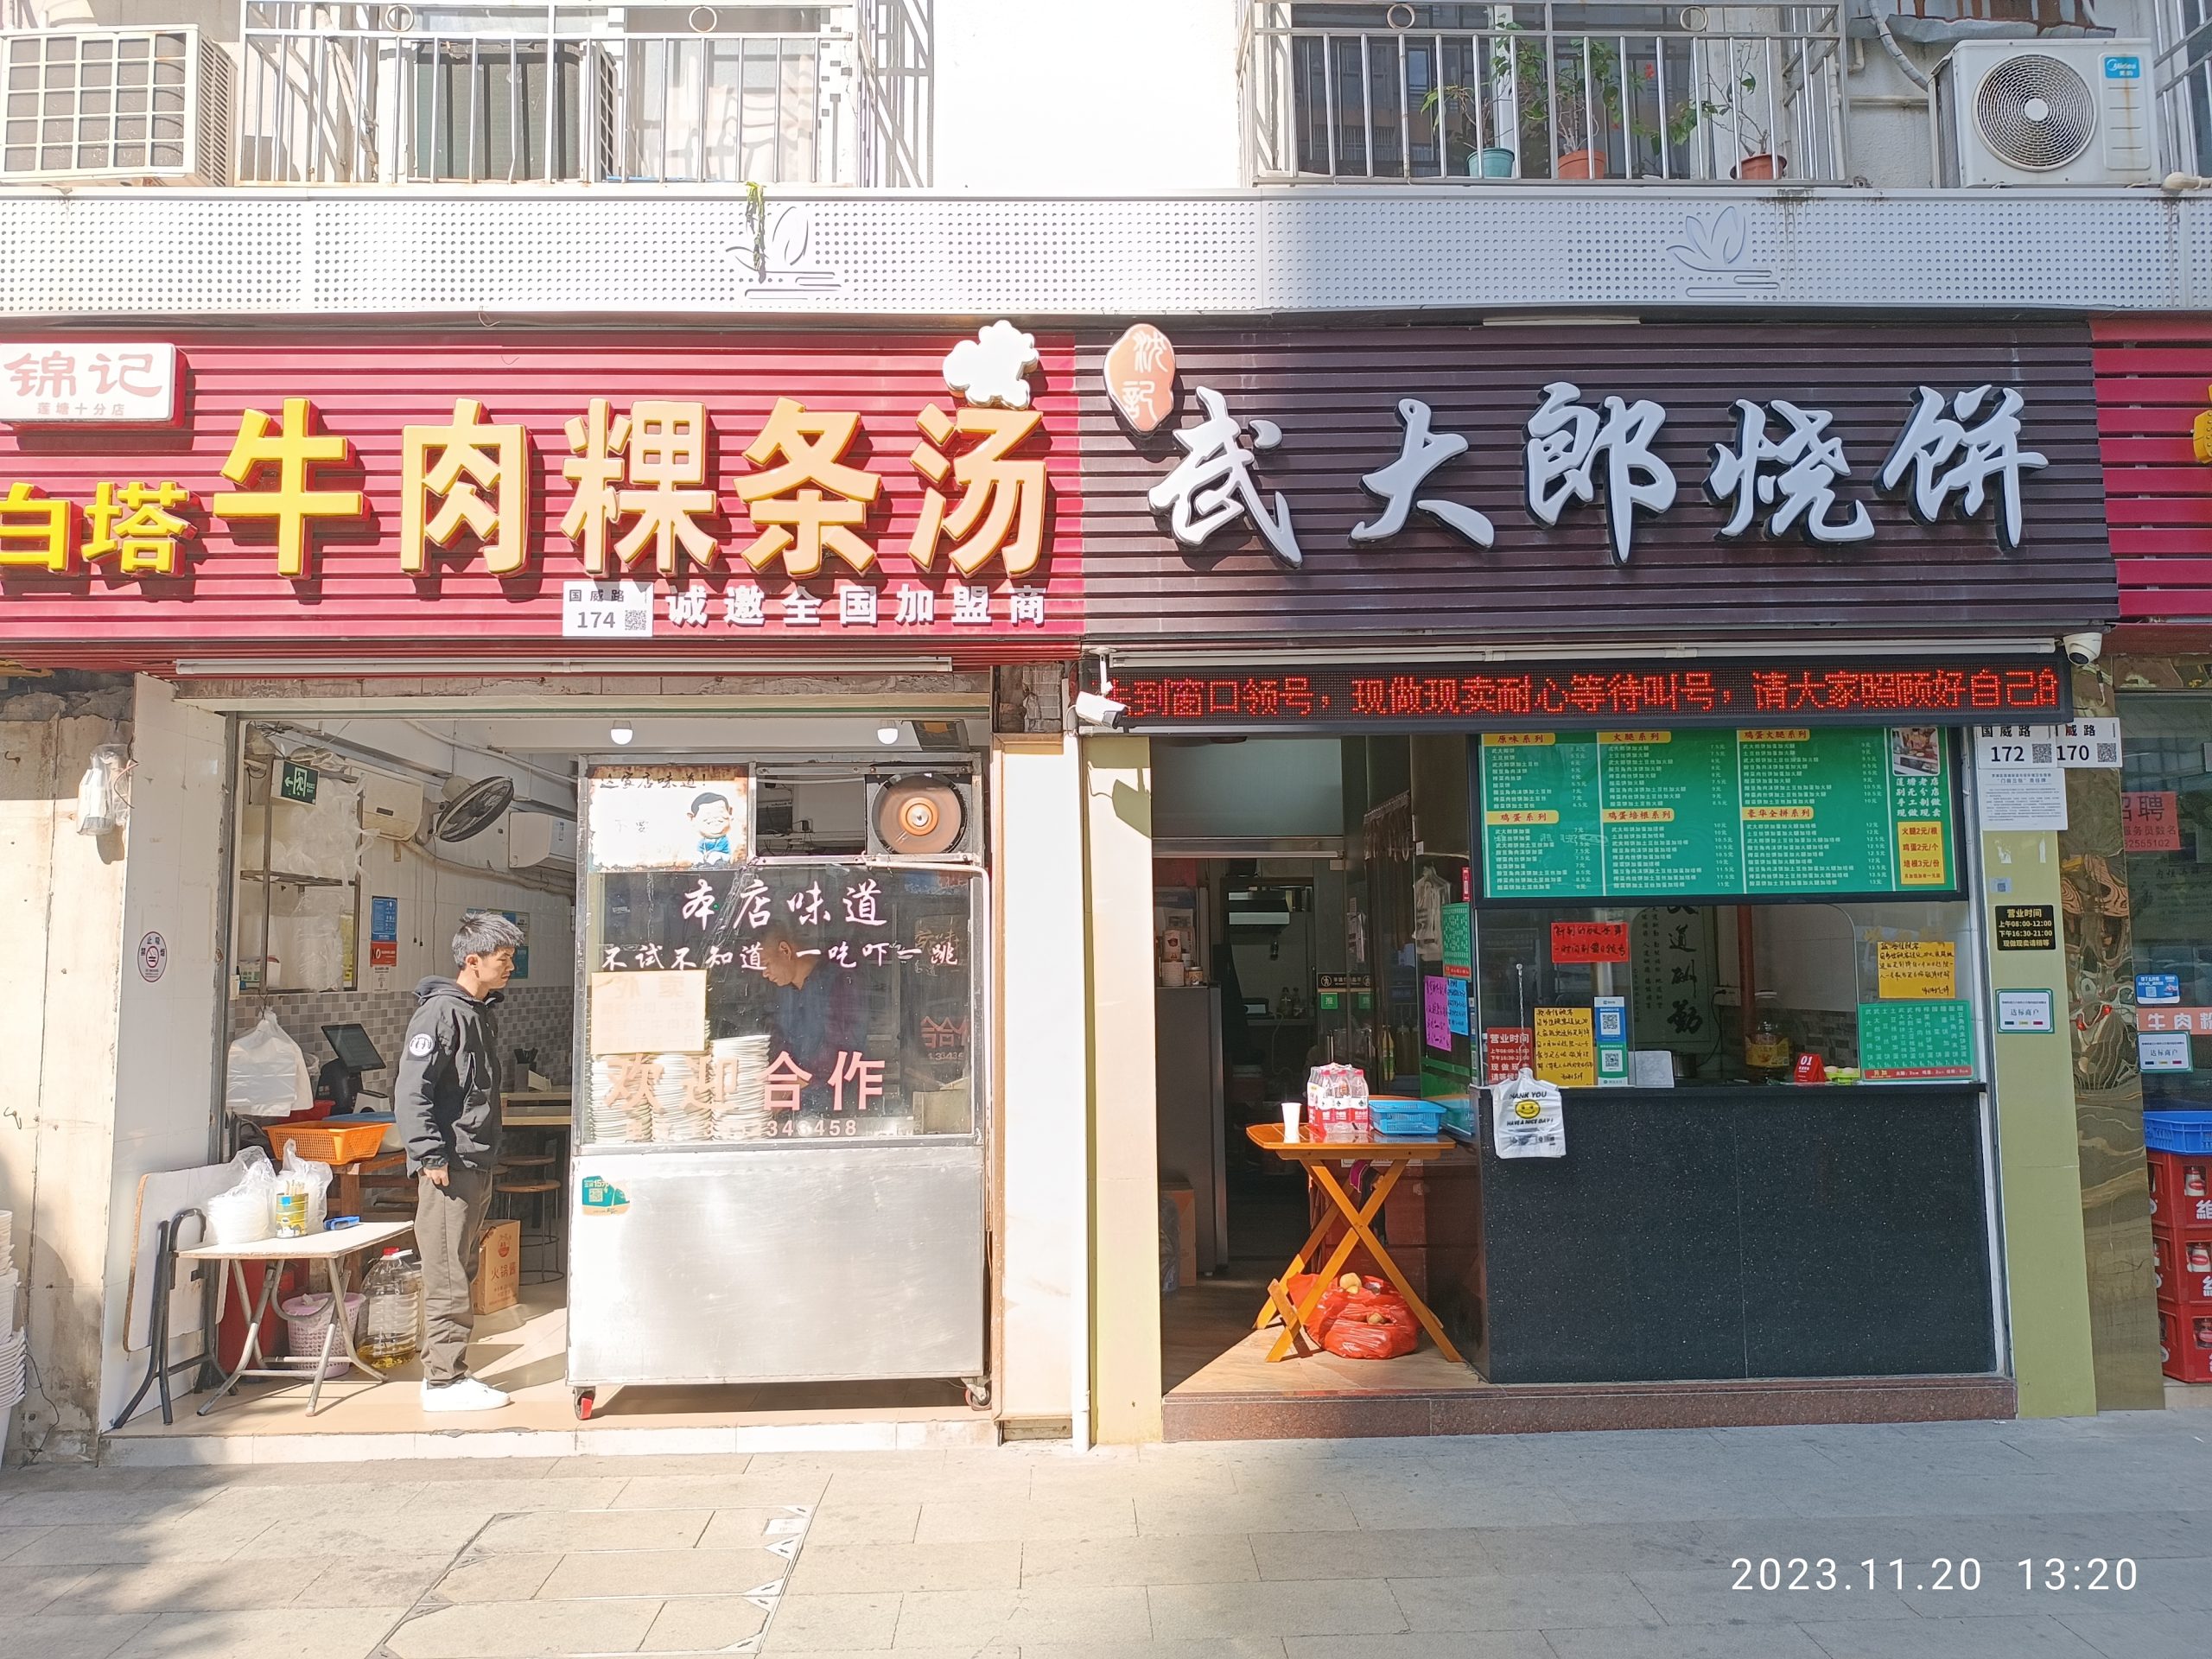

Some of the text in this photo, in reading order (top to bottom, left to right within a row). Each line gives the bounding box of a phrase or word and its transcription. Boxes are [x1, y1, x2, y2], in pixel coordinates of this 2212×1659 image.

[3, 349, 163, 398] 锦记
[37, 401, 125, 416] 莲塘十分店
[1148, 381, 2049, 569] 武大郎烧饼
[0, 397, 1047, 579] 白塔 牛肉粿条汤
[569, 588, 626, 602] 国威路
[665, 584, 1046, 627] 诚邀全国加盟商
[577, 612, 616, 630] 174
[1613, 733, 1660, 741] 火腿系列
[1744, 730, 1807, 740] 鸡蛋火腿系列
[1981, 725, 2031, 738] 国威路
[2056, 724, 2096, 737] 威路
[1497, 734, 1544, 743] 原味系列
[1991, 746, 2024, 762] 172
[2056, 745, 2089, 761] 170
[1501, 812, 1548, 822] 鸡蛋系列
[1609, 810, 1671, 820] 鸡蛋培根系列
[1747, 809, 1810, 817] 豪华全拼系列
[1897, 809, 1942, 817] 现做现卖
[682, 878, 887, 931] 本店味道
[2006, 908, 2042, 918] 营业时间
[1999, 919, 2052, 928] 上午08:00-12:00
[1999, 929, 2053, 938] 下午16:30-21:00
[601, 944, 768, 971] 不试不知道
[795, 941, 958, 969] 一吃吓一跳
[2136, 1012, 2212, 1031] 牛肉粉
[1490, 1033, 1529, 1044] 营业时间
[1800, 1056, 1812, 1065] 01
[604, 1049, 886, 1111] 欢迎合作
